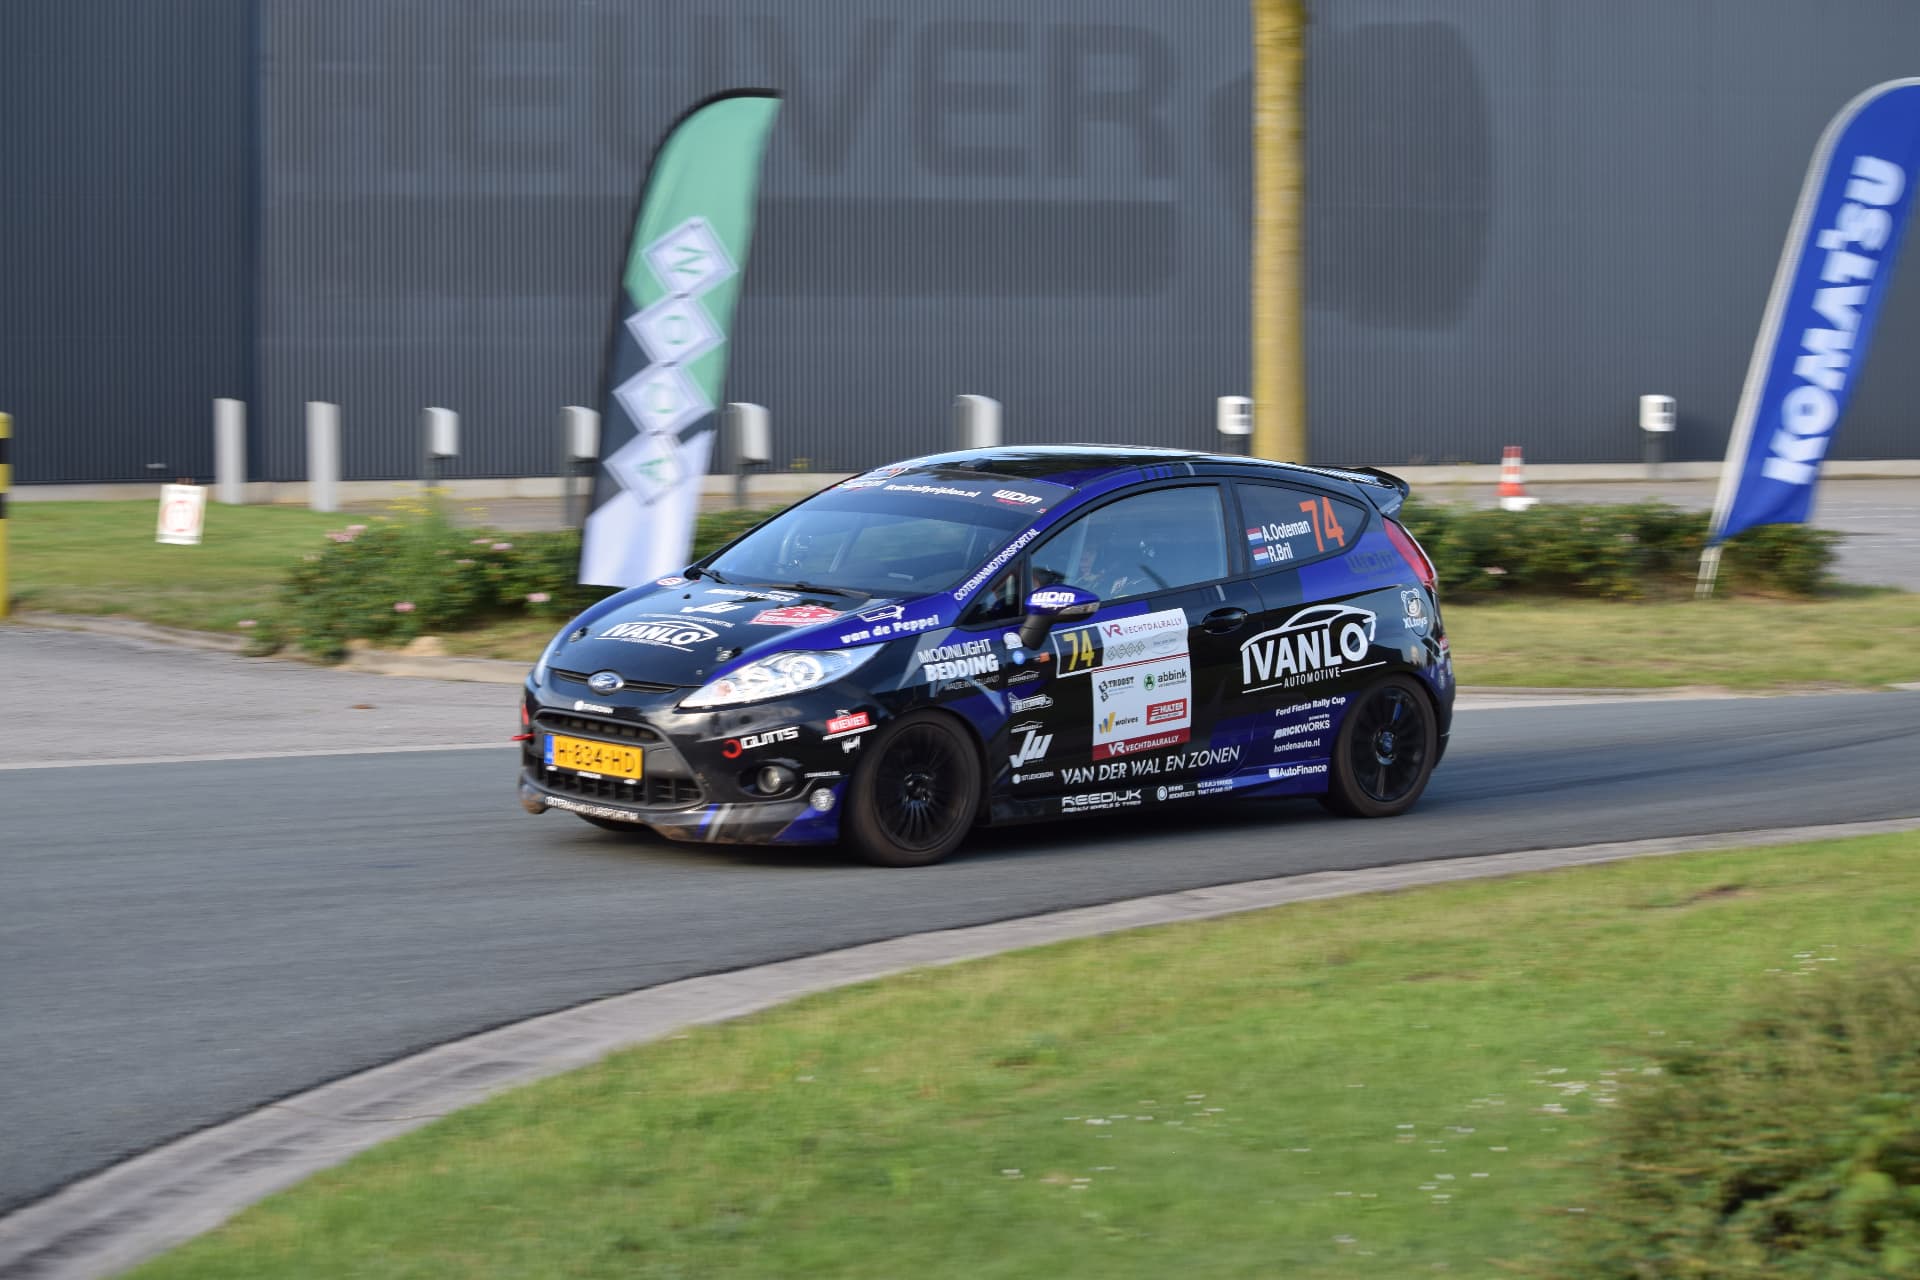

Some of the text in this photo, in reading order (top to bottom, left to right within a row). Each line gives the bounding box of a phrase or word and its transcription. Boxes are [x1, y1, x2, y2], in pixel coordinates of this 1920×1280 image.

[1761, 155, 1906, 485] KOMATSU
[1261, 520, 1311, 542] A.Ooteman
[1299, 496, 1345, 552] 74
[1267, 542, 1293, 563] R.Bril
[953, 528, 1041, 601] OOTEMANMOTORSPORT.NL
[599, 624, 702, 645] IVANLO
[840, 614, 940, 644] van de Peppel
[917, 638, 992, 663] MOONLIGHT
[1063, 630, 1096, 671] 74
[1241, 622, 1369, 685] IVANLO
[923, 653, 1000, 682] BEDDING
[1157, 668, 1187, 683] abbink
[1284, 666, 1341, 688] AUTOMOTIVE
[1275, 706, 1291, 717] Ford
[1312, 698, 1330, 708] Rally
[1331, 696, 1346, 705] Cup
[1108, 735, 1179, 755] VR VECHTDALRALLY
[1274, 738, 1320, 752] hondenauto.nl
[1061, 766, 1095, 785] VAN
[1098, 763, 1128, 781] DER
[1131, 757, 1161, 776] WAL
[1165, 752, 1186, 771] EN
[1189, 745, 1241, 768] ZONEN
[1062, 788, 1141, 807] REEDIJK
